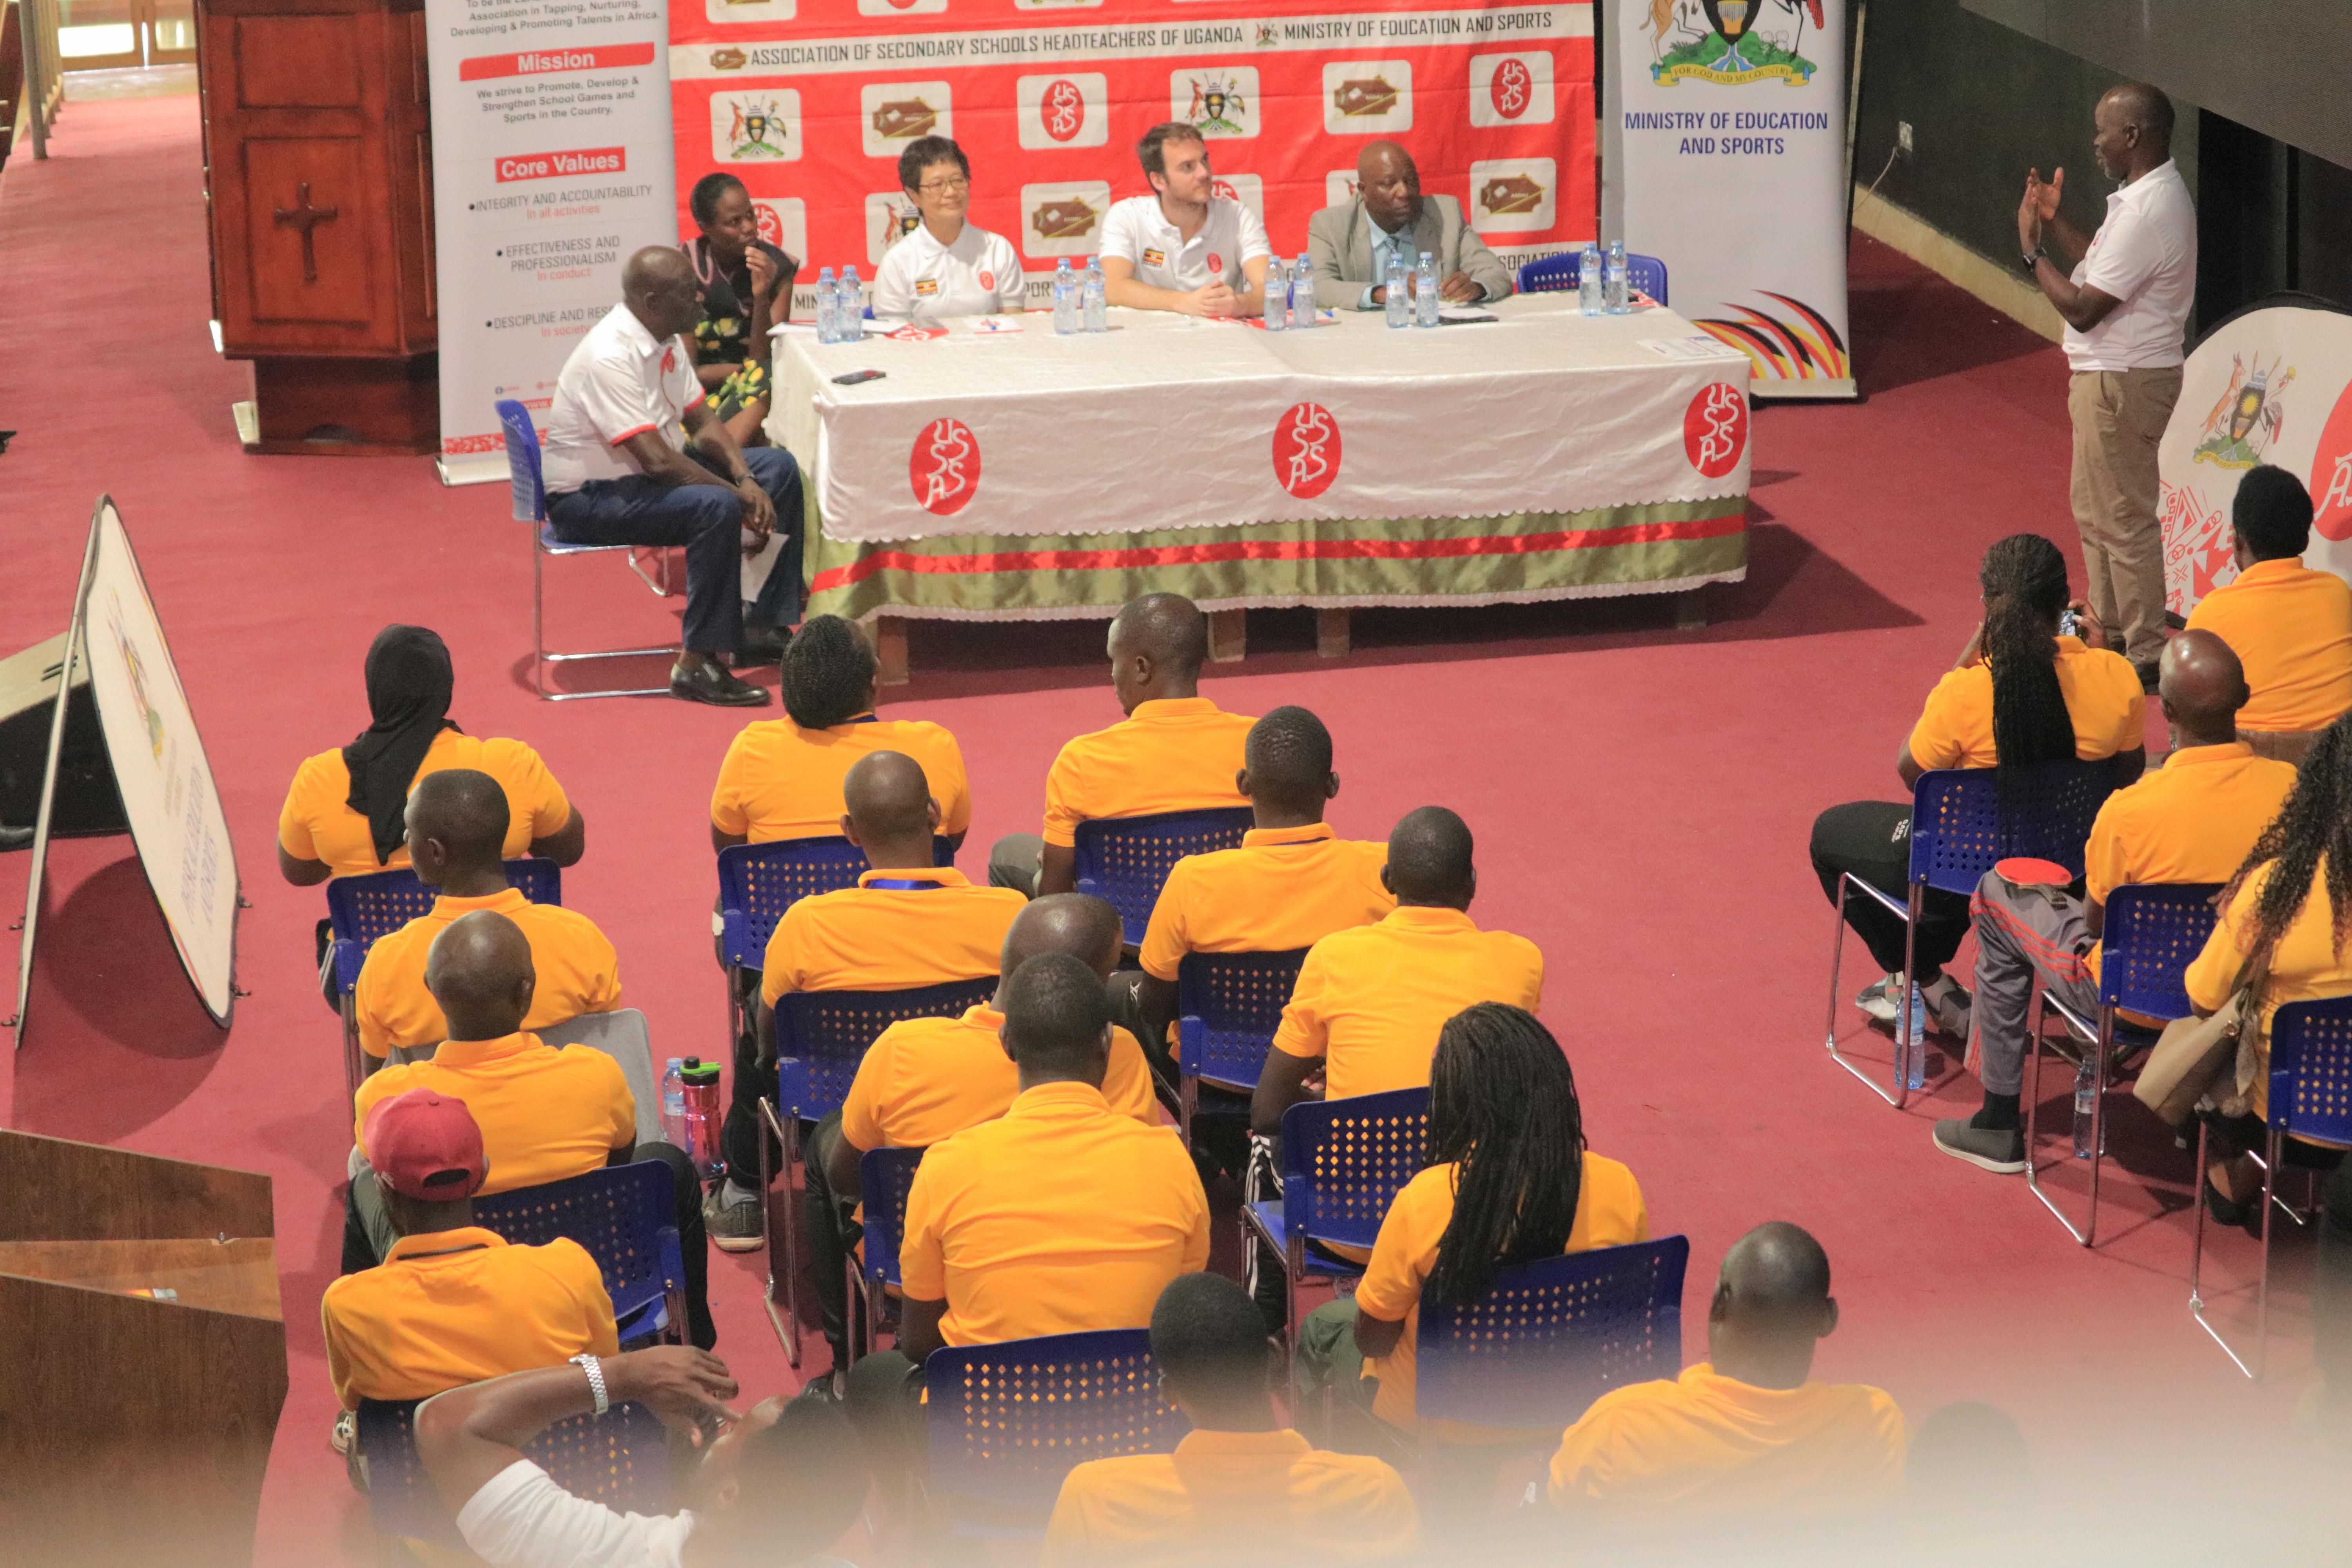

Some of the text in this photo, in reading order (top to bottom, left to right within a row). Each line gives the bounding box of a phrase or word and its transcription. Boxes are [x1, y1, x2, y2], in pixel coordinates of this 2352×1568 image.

[451, 24, 506, 37] Developing
[510, 22, 517, 30] &
[520, 18, 573, 29] Promoting
[576, 15, 612, 24] Talents
[469, 9, 527, 21] Association
[1285, 12, 1552, 40] MINISTRY OF EDUCATION AND SPORTS
[751, 26, 1243, 65] ASSOCIATION OF SECONDARY SCHOOLS HEADTEACHERS OF UGANDA
[517, 51, 595, 73] Mission
[1674, 66, 1691, 76] FOR
[1693, 68, 1713, 78] GOD
[1715, 74, 1732, 82] AND
[1749, 65, 1790, 78] COUNTRY
[477, 90, 492, 98] We
[495, 87, 522, 96] strive
[587, 78, 628, 89] Develop
[632, 76, 639, 84] &
[482, 89, 635, 113] Strengthen School Games and
[503, 111, 536, 123] Sports
[539, 109, 548, 119] in
[551, 107, 567, 118] the
[1625, 112, 1828, 129] MINISTRY OF EDUCATION
[1679, 137, 1784, 154] AND SPORTS
[501, 154, 619, 178] Core Values
[476, 184, 652, 212] INTEGRITY AND ACCOUNTABILITY
[554, 204, 600, 216] activities
[506, 235, 620, 257] EFFECTIVENESS AND
[511, 252, 616, 270] PROFESSIONALISM
[550, 267, 592, 281] conduct
[494, 311, 556, 329] DESCIPLINE
[559, 307, 584, 321] AND
